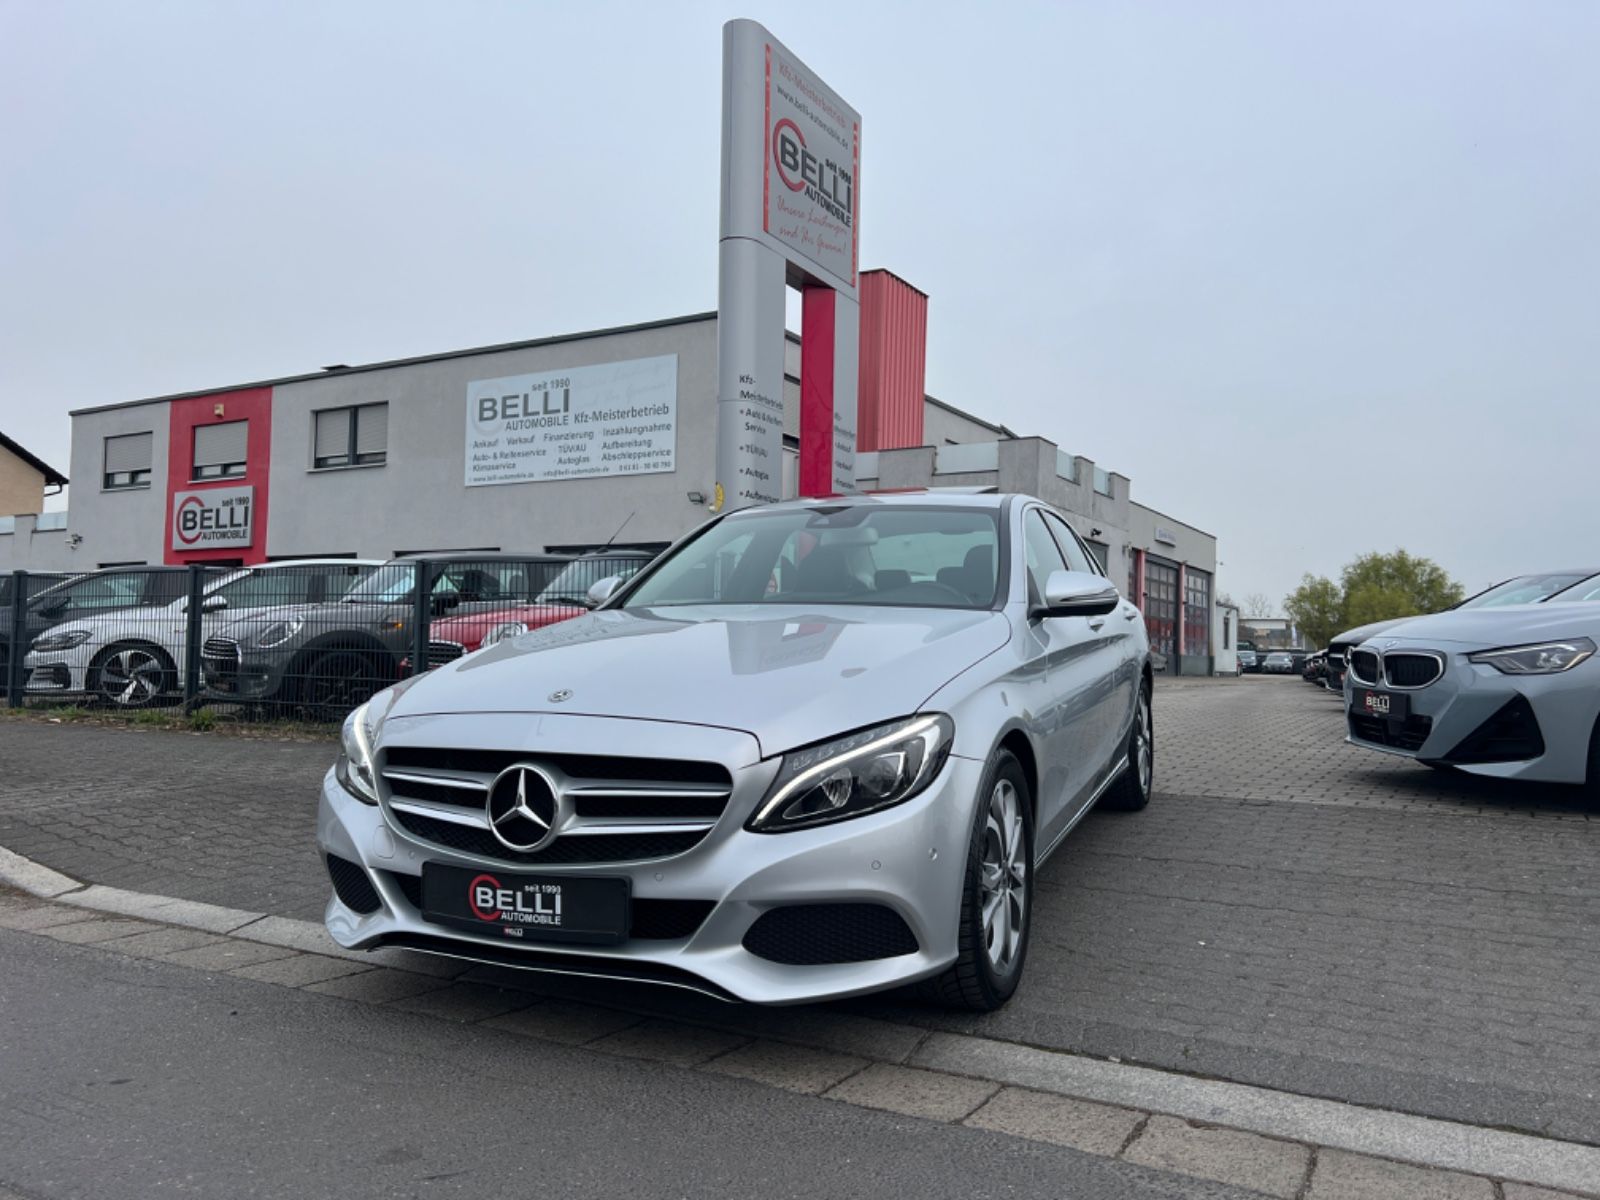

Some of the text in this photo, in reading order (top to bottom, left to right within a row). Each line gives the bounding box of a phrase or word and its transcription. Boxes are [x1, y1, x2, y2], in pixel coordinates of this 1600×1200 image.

[780, 134, 851, 213] BELLI
[804, 185, 851, 227] AUTOMOBILE
[531, 378, 570, 391] seit 1990
[478, 389, 570, 421] BELLI
[505, 404, 669, 431] AUTOMOBILE Kfz-Meisterbetrieb
[472, 423, 672, 449] Ankauf Verkauf Finanzierung Inzahlungnahme
[601, 440, 652, 450] Aufbereitung
[601, 449, 671, 461] Abschleppservice
[222, 498, 234, 507] seit
[182, 507, 249, 530] BELLI
[201, 530, 247, 541] AUTOMOBILE
[1366, 697, 1389, 708] BELLI
[524, 885, 561, 894] seit 1990
[475, 887, 561, 914] BELLI
[501, 912, 561, 925] AUTOMOBILE
